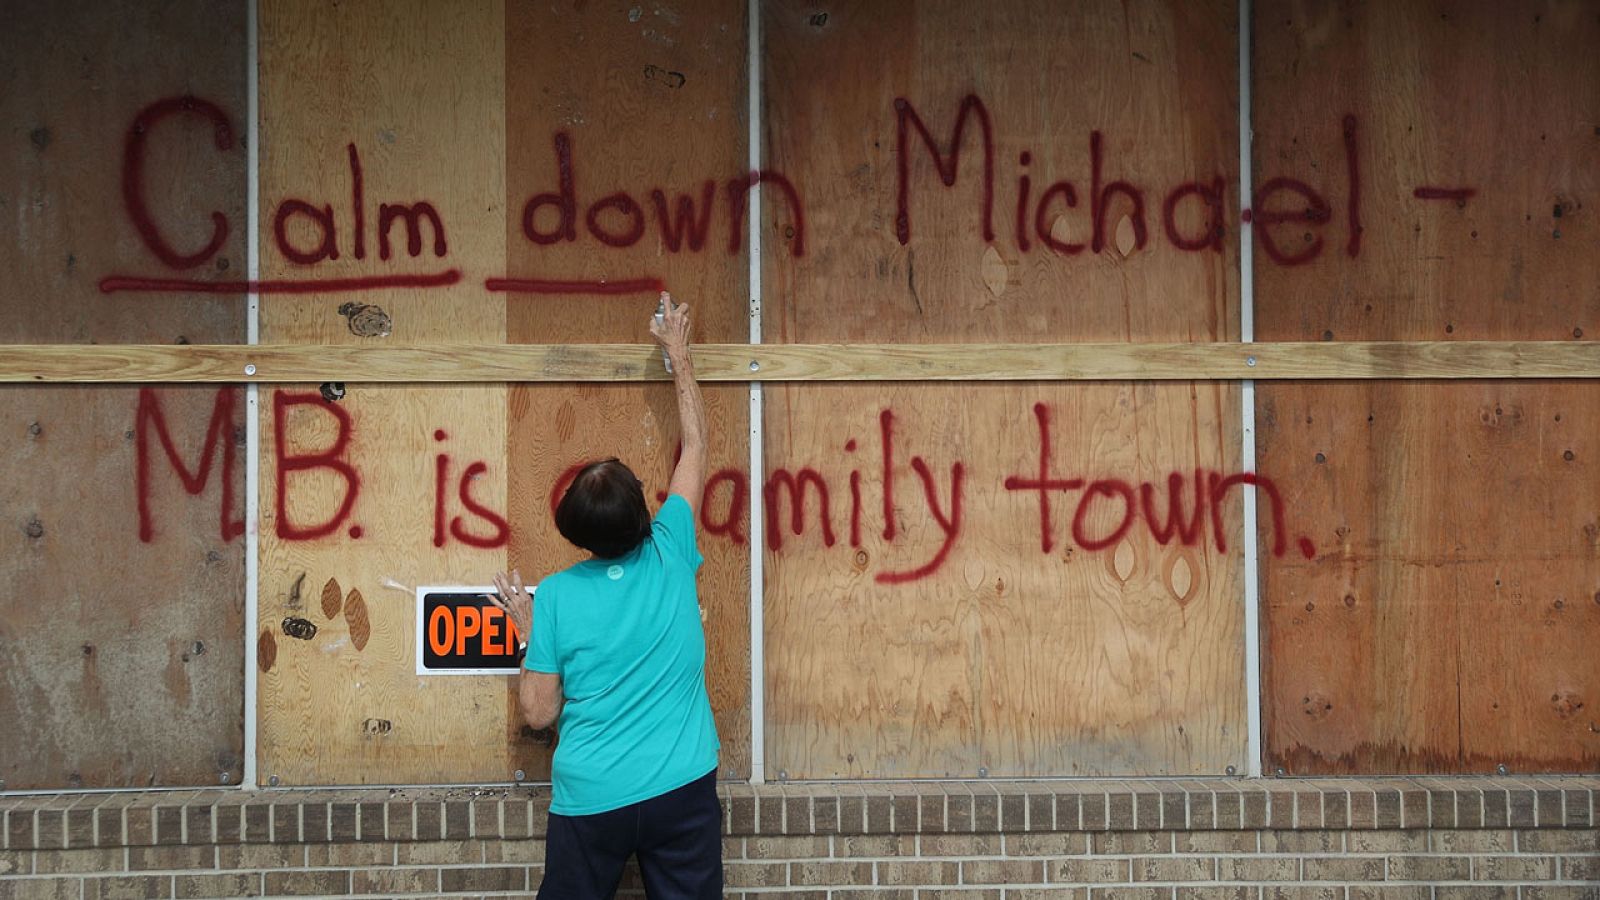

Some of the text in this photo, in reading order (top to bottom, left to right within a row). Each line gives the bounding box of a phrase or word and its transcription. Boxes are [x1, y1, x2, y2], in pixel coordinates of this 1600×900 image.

[120, 95, 449, 269] Calm
[521, 130, 806, 256] down
[892, 92, 1363, 266] Michael
[433, 428, 511, 549] is
[655, 408, 965, 585] amily
[1004, 401, 1317, 559] town.
